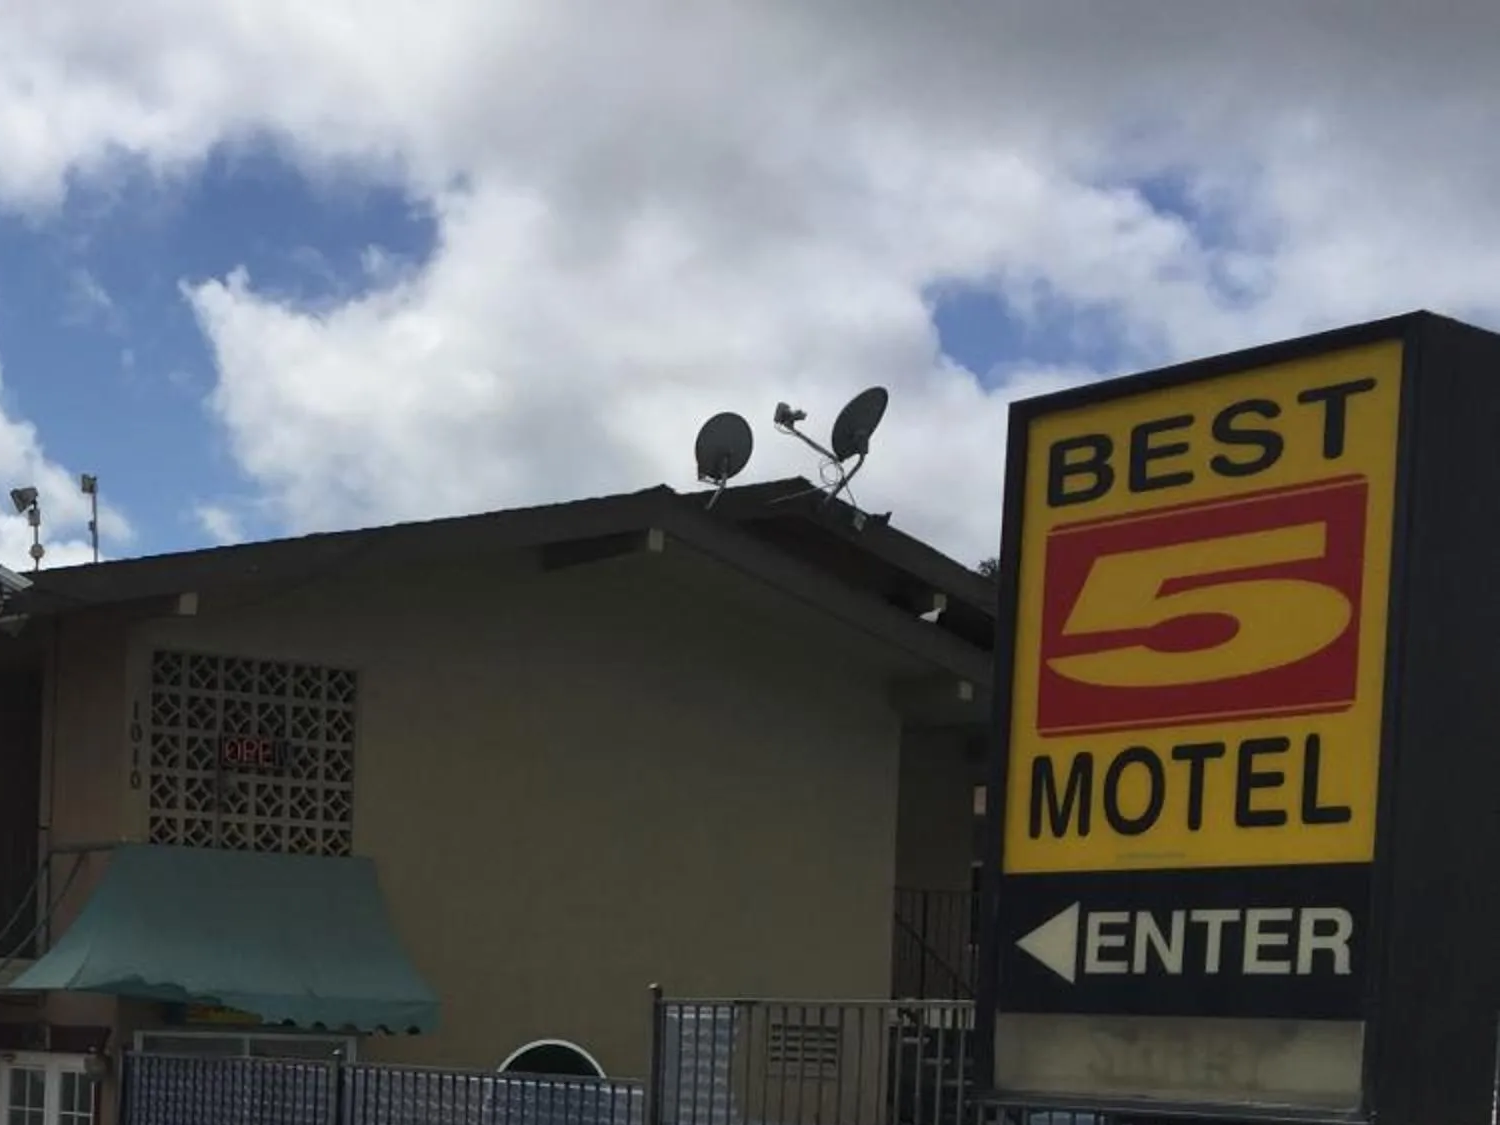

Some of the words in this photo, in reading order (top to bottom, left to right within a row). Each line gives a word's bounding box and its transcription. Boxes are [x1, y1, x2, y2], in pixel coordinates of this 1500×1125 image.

[1046, 377, 1376, 509] BEST
[1045, 521, 1352, 687] 5
[130, 700, 143, 790] 1010
[1028, 733, 1352, 840] MOTEL
[1083, 906, 1354, 976] ENTER
